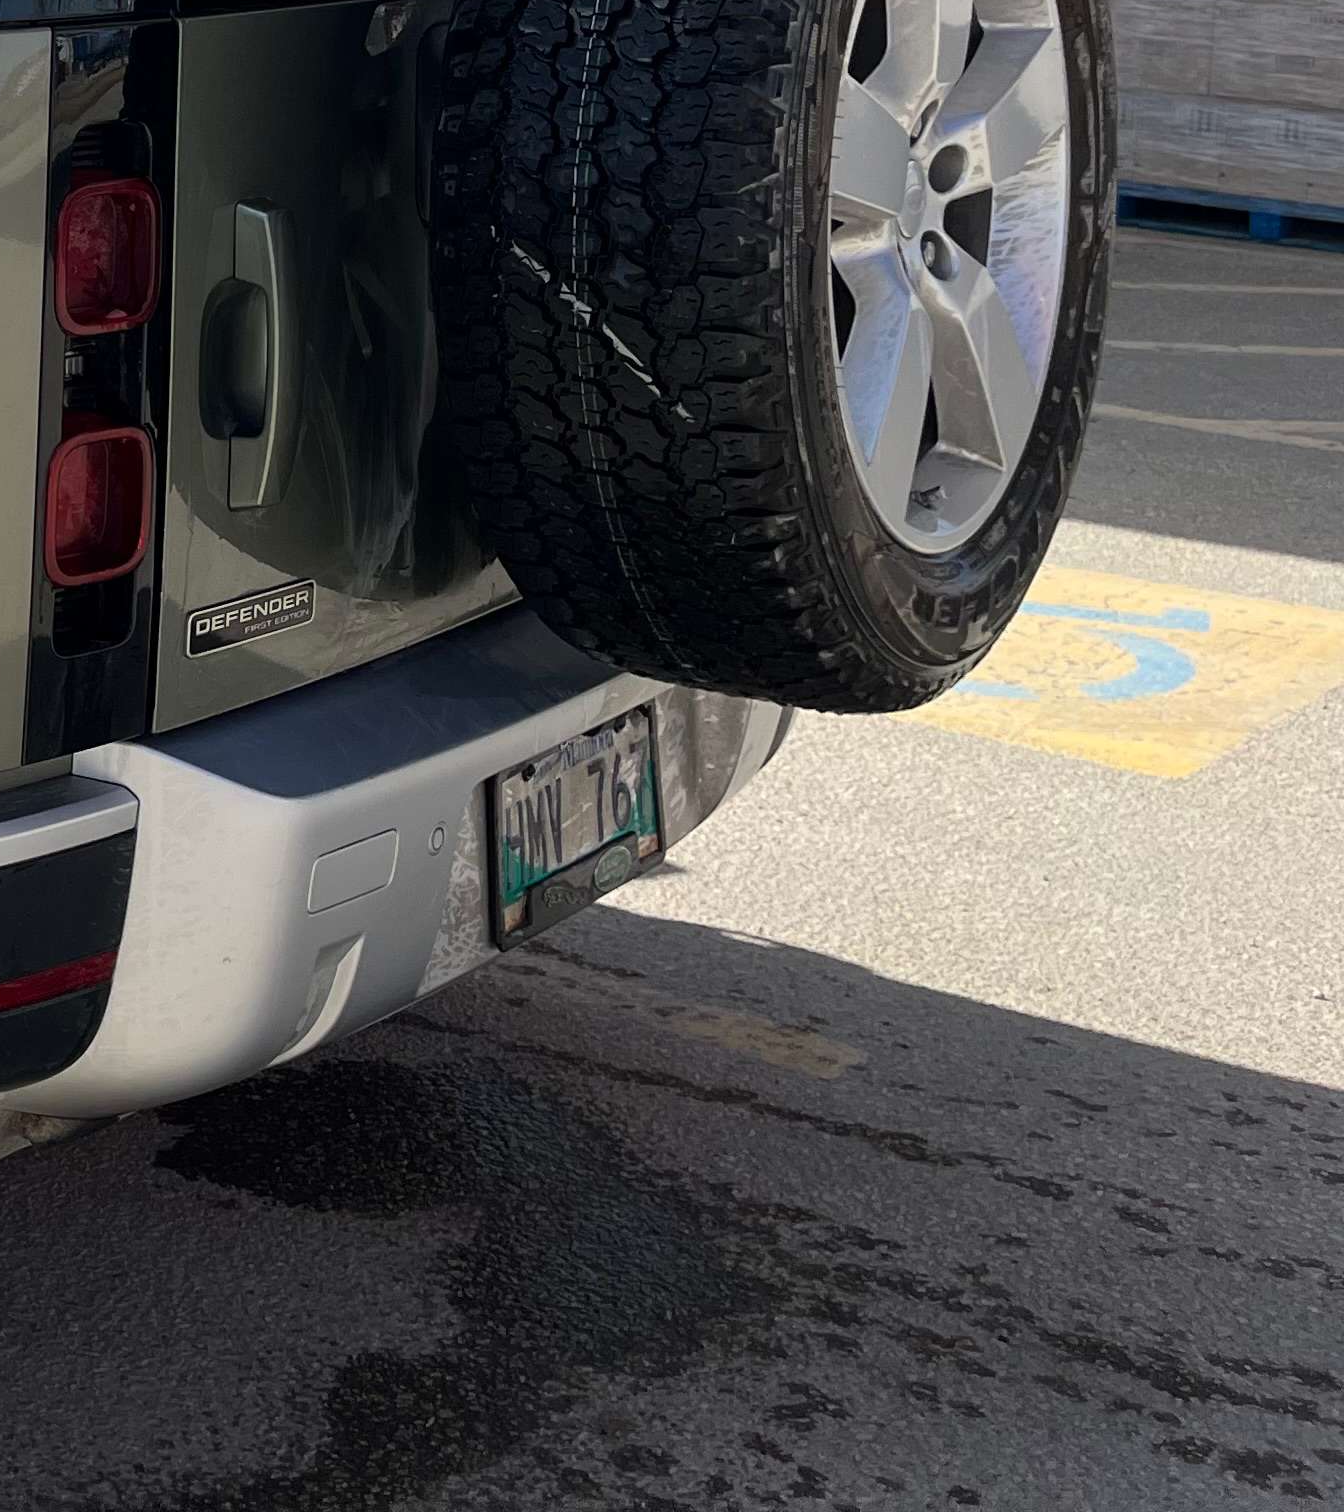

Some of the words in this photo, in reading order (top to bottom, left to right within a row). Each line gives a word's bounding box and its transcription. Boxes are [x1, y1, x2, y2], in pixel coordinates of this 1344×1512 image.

[195, 589, 309, 636] DEFENDER
[244, 620, 272, 634] FIRST
[274, 608, 310, 625] EDITION
